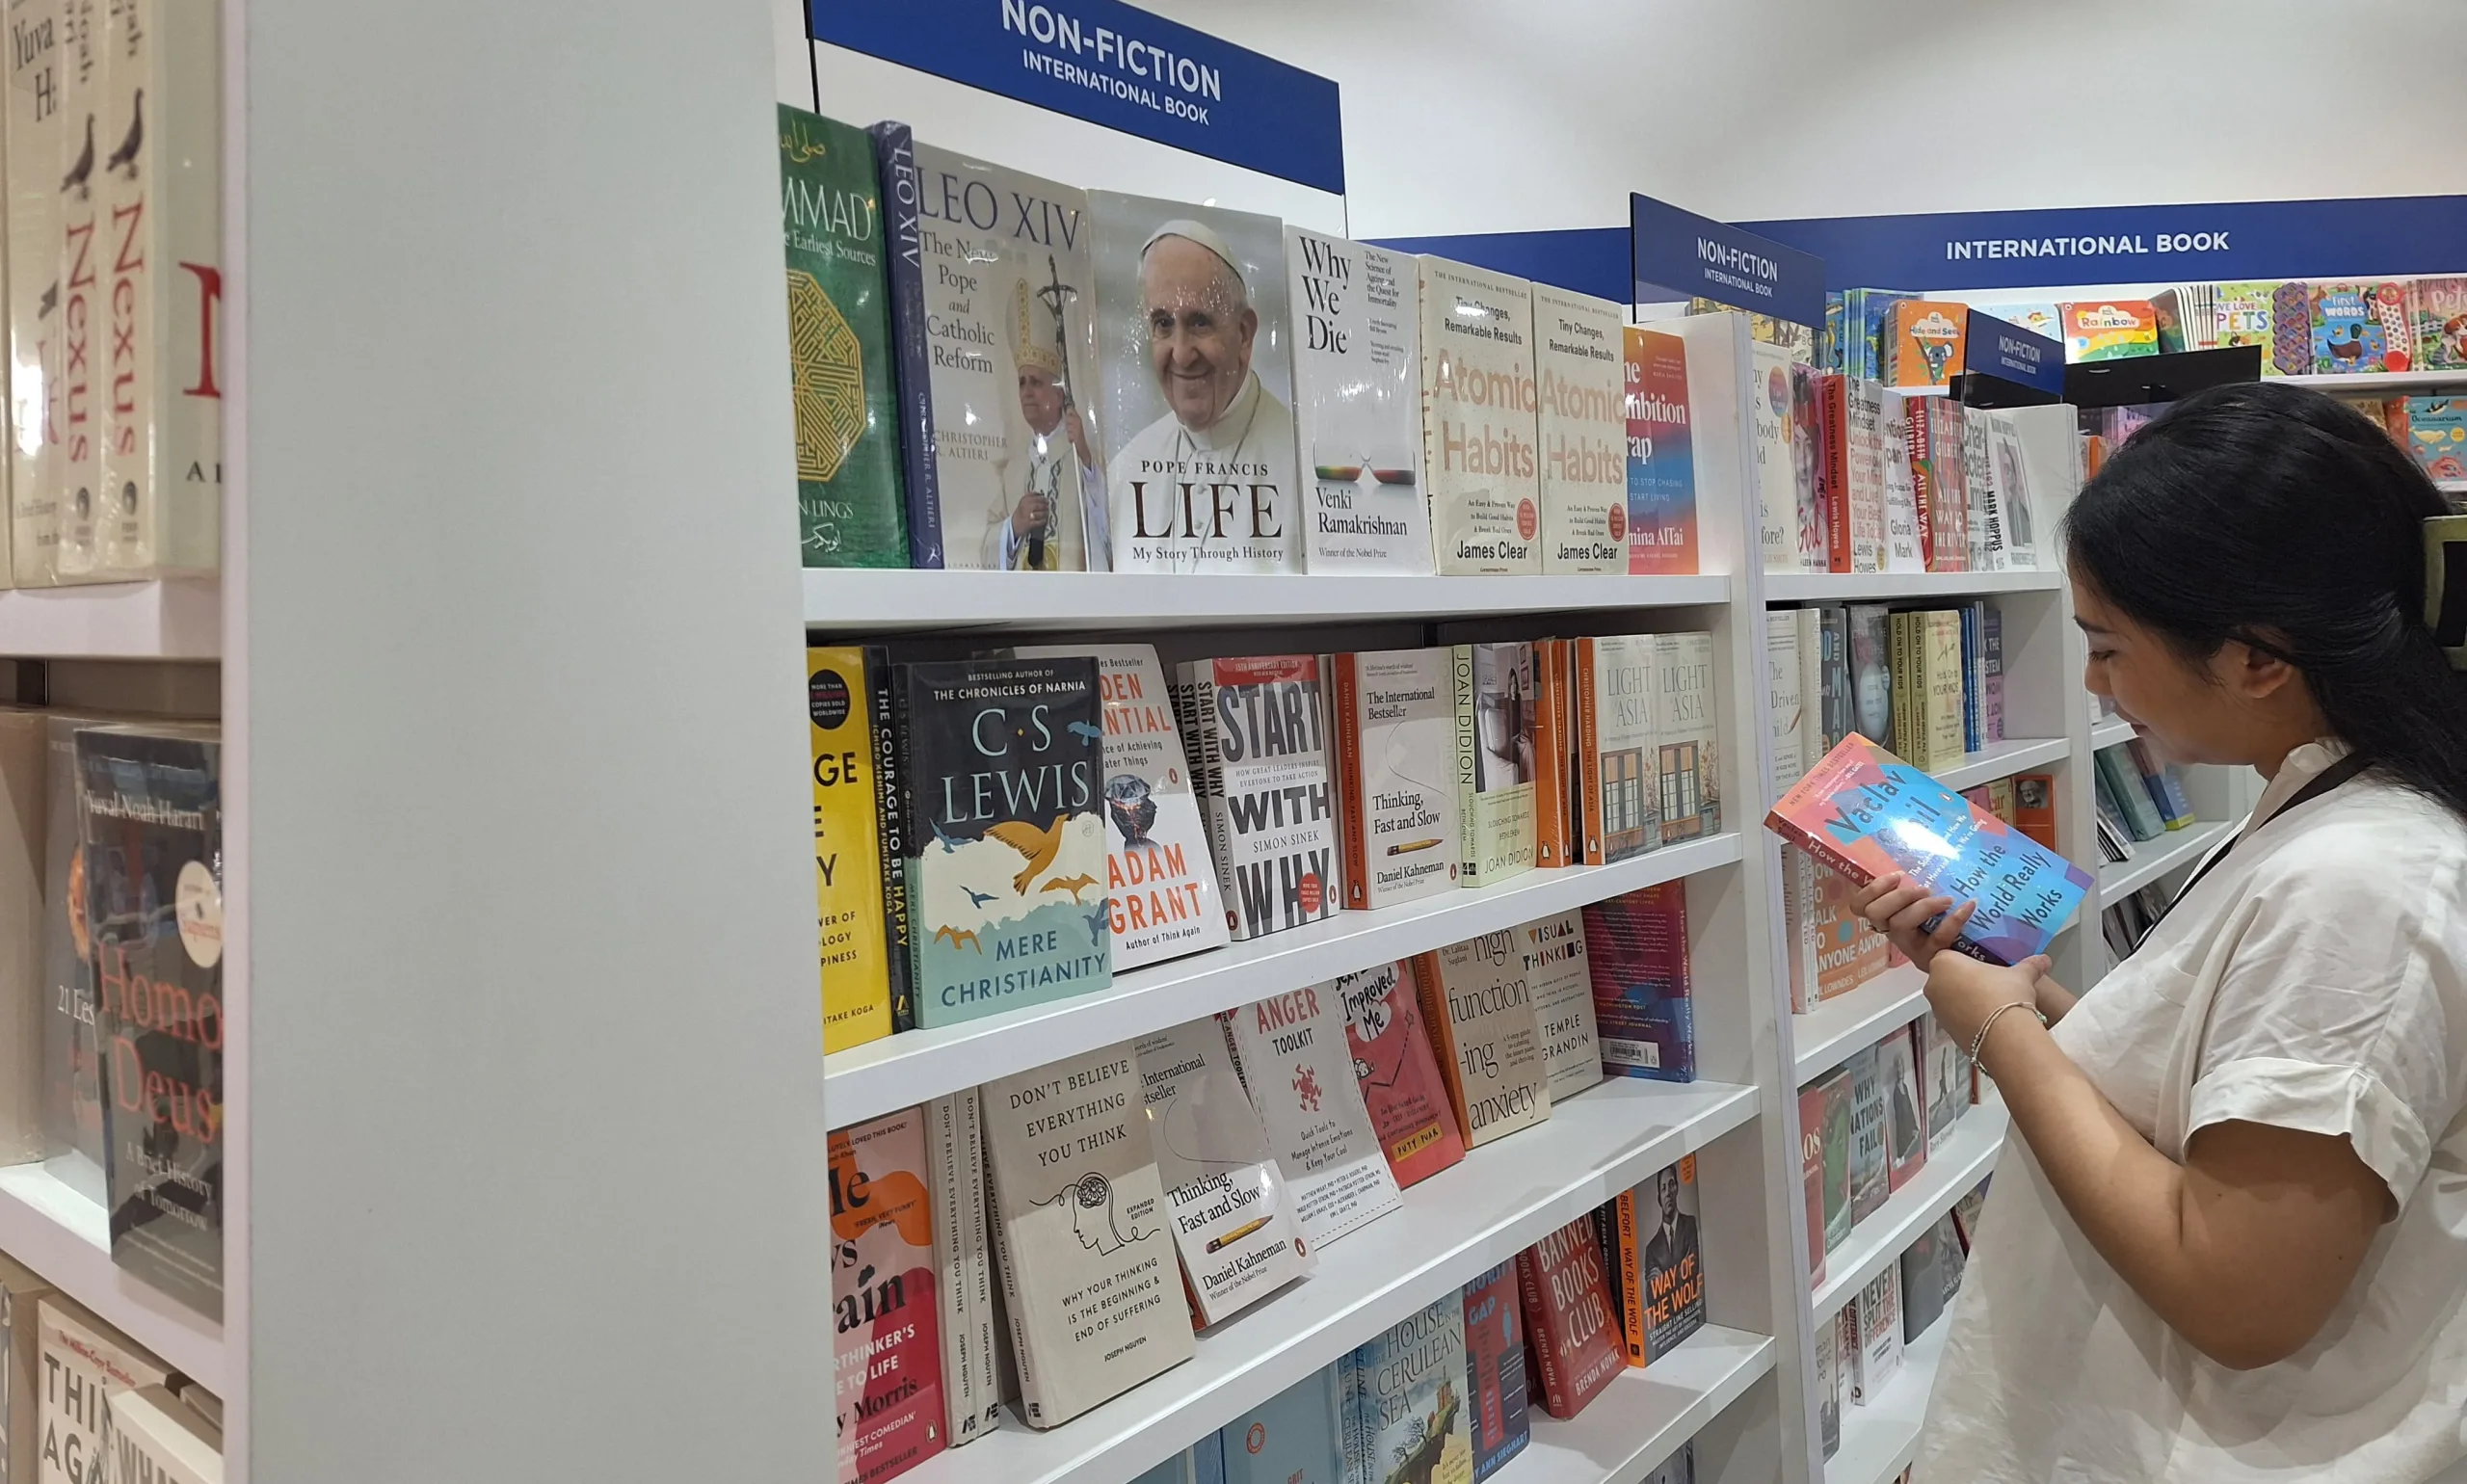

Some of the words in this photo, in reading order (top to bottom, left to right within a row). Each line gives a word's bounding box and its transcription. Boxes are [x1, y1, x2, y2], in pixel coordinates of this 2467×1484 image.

[1002, 0, 1221, 102] NON-FICTION
[1023, 49, 1160, 111] INTERNATIONAL
[1165, 96, 1209, 126] BOOK
[893, 147, 915, 205] LEO
[915, 166, 998, 230] LEO
[1012, 193, 1080, 252] XIV
[898, 211, 920, 269] XIV
[1697, 236, 1778, 282] NON-FICTION
[1947, 235, 2148, 260] INTERNATIONAL
[2156, 231, 2230, 252] BOOK
[939, 264, 977, 291] Pope
[1299, 236, 1351, 289] Why
[1301, 276, 1340, 315] We
[1704, 268, 1754, 295] INTERNATIONAL
[1755, 279, 1774, 298] BOOK
[2333, 296, 2356, 305] First
[112, 196, 145, 457] Nexus
[948, 299, 970, 315] and
[2082, 317, 2136, 328] Rainbow
[2216, 311, 2268, 331] PETS
[2324, 306, 2366, 317] WORDS
[66, 222, 95, 464] Nexus
[926, 315, 995, 346] Catholic
[1307, 315, 1348, 355] Die
[1446, 318, 1491, 338] Remarkable
[1494, 327, 1523, 345] Results
[1558, 319, 1573, 337] Tiny
[1574, 322, 1605, 341] Changes,
[1999, 334, 2041, 363] NON-FICTION
[934, 345, 994, 374] Reform
[1549, 338, 1587, 358] Remarkable
[1590, 346, 1614, 362] Results
[1434, 348, 1536, 413] Atomic
[1540, 367, 1626, 425] Atomic
[1848, 393, 1880, 414] Greatness
[1848, 412, 1876, 432] Mindset
[2412, 414, 2462, 424] Oceanarium
[934, 430, 1007, 448] CHRISTOPHER
[1443, 420, 1534, 478] Habits
[1141, 460, 1185, 475] POPE
[1194, 462, 1269, 477] FRANCIS
[1546, 433, 1623, 485] Habits
[1129, 482, 1283, 539] LIFE
[1315, 488, 1352, 510] Venki
[1318, 513, 1407, 536] Ramakrishnan
[1890, 518, 1911, 537] Gloria
[1133, 546, 1152, 562] My
[1155, 545, 1187, 562] Story
[1190, 545, 1239, 562] Through
[1242, 546, 1284, 562] History
[1457, 541, 1495, 559] James
[1499, 542, 1527, 559] Clear
[1557, 543, 1590, 560] James
[1593, 543, 1617, 560] Clear
[1895, 542, 1913, 558] Mark
[1109, 658, 1144, 667] Bestseller
[1457, 653, 1470, 705] JOAN
[1607, 667, 1650, 696] LIGHT
[1662, 664, 1708, 693] LIGHT
[935, 690, 955, 701] THE
[958, 685, 1025, 700] CHRONICLES
[1029, 683, 1043, 694] OF
[1046, 681, 1086, 693] NARNIA
[1367, 693, 1384, 704] The
[1385, 687, 1435, 702] International
[1672, 694, 1704, 722] ASIA
[1770, 691, 1799, 709] Driven
[972, 708, 1008, 756] C
[1031, 704, 1052, 753] S
[1216, 680, 1321, 762] START
[1368, 706, 1407, 720] Bestseller
[1616, 698, 1648, 727] ASIA
[1271, 764, 1297, 775] LEADERS
[1299, 759, 1320, 770] INSPIRE
[1458, 715, 1472, 784] DIDION
[942, 760, 1090, 824] LEWIS
[1228, 782, 1330, 835] WITH
[1373, 791, 1423, 810] Thinking,
[1824, 770, 1907, 834] Vaclav
[1373, 819, 1395, 834] Fast
[1397, 816, 1416, 831] and
[1417, 810, 1440, 829] Slow
[1253, 836, 1287, 854] SIMON
[1290, 830, 1319, 846] SINEK
[1485, 856, 1505, 873] JOAN
[1509, 848, 1533, 867] DIDION
[1808, 839, 1840, 865] How
[1836, 859, 1859, 879] the
[1108, 842, 1187, 889] ADAM
[1377, 868, 1403, 884] Daniel
[1403, 861, 1444, 878] Kahneman
[1950, 867, 1987, 898] How
[1982, 844, 2006, 873] the
[1109, 883, 1202, 935] GRANT
[1236, 847, 1329, 939] WHY
[1969, 885, 2015, 932] World
[2003, 850, 2053, 895] Really
[2020, 887, 2062, 931] Works
[995, 930, 1057, 962] MERE
[1527, 918, 1574, 944] VISUAL
[98, 941, 223, 1050] Homo
[941, 952, 1106, 1008] CHRISTIANITY
[1342, 969, 1395, 1024] Improved
[851, 1004, 874, 1018] KOGA
[1257, 987, 1320, 1035] ANGER
[1448, 977, 1530, 1024] function
[1272, 1027, 1314, 1057] TOOLKIT
[1363, 1010, 1385, 1042] Me
[1544, 1014, 1580, 1038] TEMPLE
[1460, 1039, 1499, 1080] -ing
[1542, 1033, 1589, 1061] GRANDIN
[113, 1034, 216, 1145] Deus
[1009, 1080, 1061, 1110] DON'T
[1068, 1059, 1130, 1092] BELIEVE
[1854, 1076, 1875, 1105] WHY
[1026, 1092, 1127, 1138] EVERYTHING
[1471, 1080, 1538, 1130] anxiety
[1038, 1142, 1072, 1168] YOU
[1077, 1124, 1127, 1154] THINK
[1859, 1125, 1877, 1157] FAIL
[1127, 1198, 1155, 1215] EXPANDED
[1167, 1172, 1234, 1207] Thinking,
[1178, 1215, 1207, 1234] Fast
[1208, 1203, 1233, 1224] and
[1231, 1185, 1260, 1212] Slow
[1062, 1291, 1083, 1307] WHY
[1087, 1282, 1112, 1299] YOUR
[1115, 1258, 1158, 1285] THINKING
[1202, 1263, 1237, 1290] Daniel
[1237, 1239, 1287, 1277] Kahneman
[1552, 1247, 1599, 1312] BOOKS
[1650, 1264, 1679, 1300] WAY
[1681, 1252, 1695, 1281] OF
[1644, 1297, 1670, 1330] THE
[1671, 1273, 1703, 1312] WOLF
[1862, 1264, 1894, 1313] NEVER
[1074, 1326, 1093, 1342] END
[1097, 1322, 1109, 1336] OF
[1113, 1294, 1161, 1325] SUFFERING
[1469, 1296, 1496, 1325] GAP
[1568, 1291, 1605, 1348] CLUB
[1387, 1302, 1445, 1360] HOUSE
[870, 1356, 899, 1380] LIFE
[1377, 1322, 1462, 1395] CERULEAN
[1575, 1368, 1600, 1396] BRENDA
[1600, 1348, 1620, 1373] NOVAK
[854, 1376, 918, 1424] Morris
[1379, 1389, 1411, 1431] SEA
